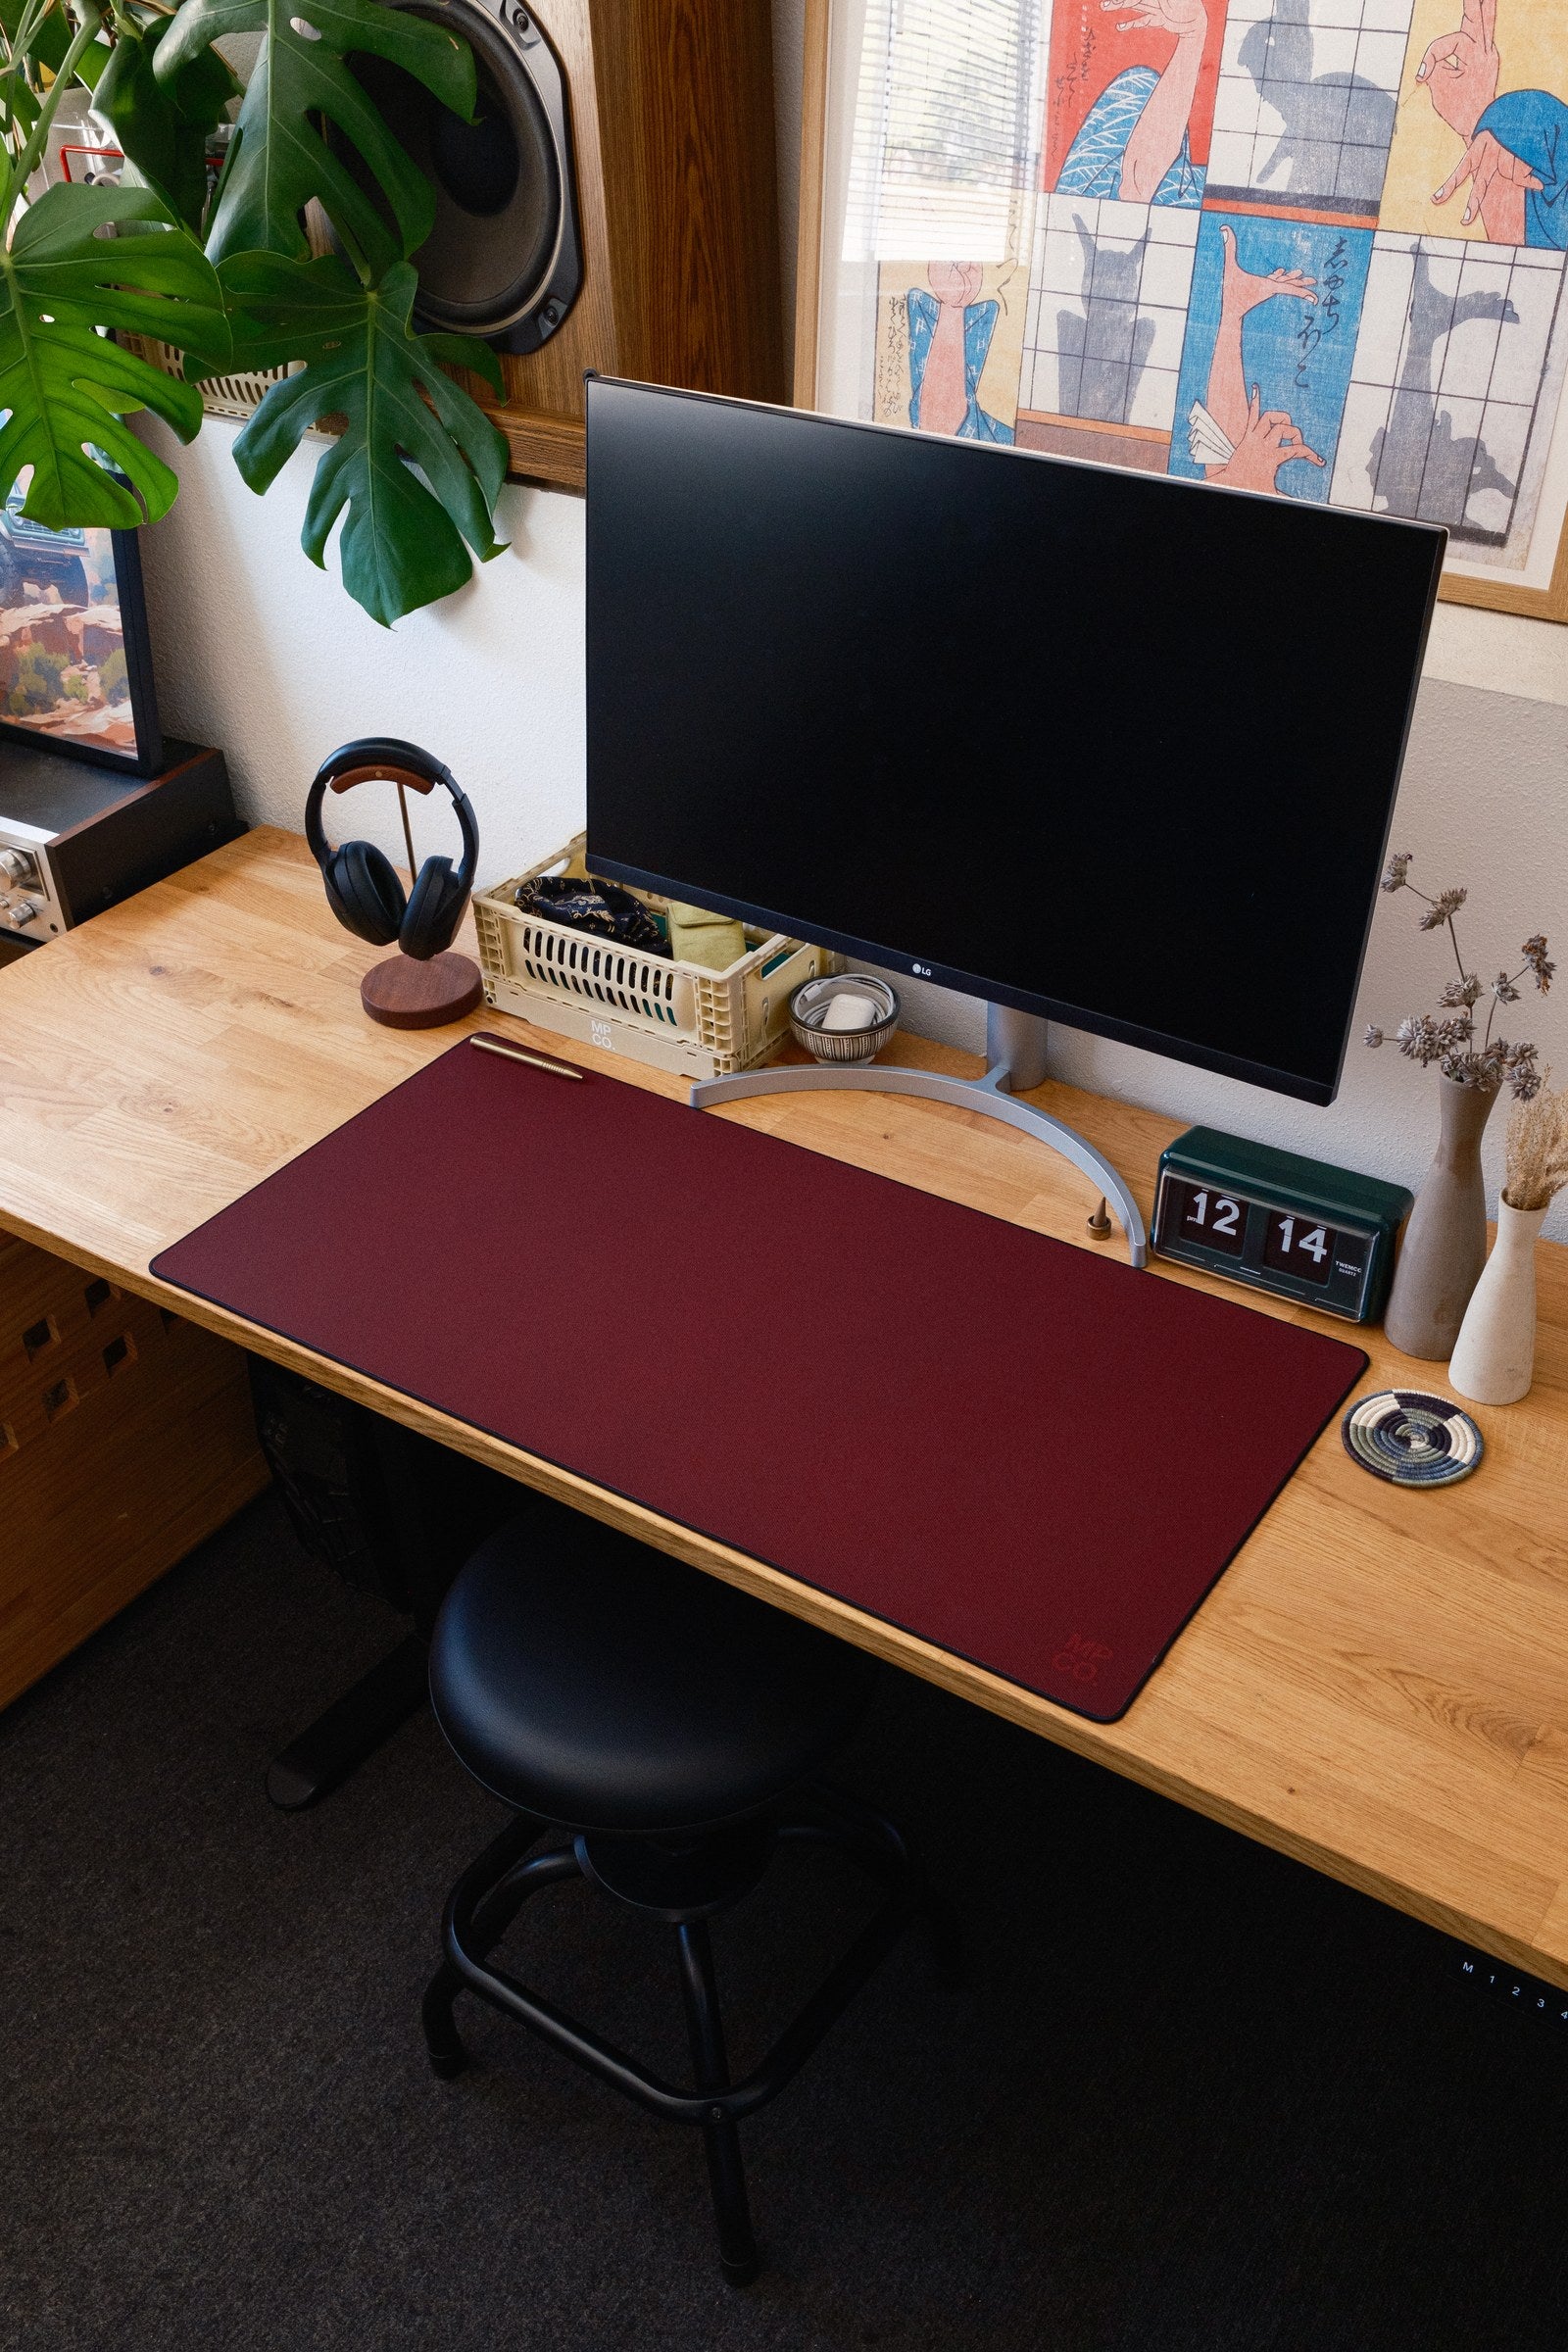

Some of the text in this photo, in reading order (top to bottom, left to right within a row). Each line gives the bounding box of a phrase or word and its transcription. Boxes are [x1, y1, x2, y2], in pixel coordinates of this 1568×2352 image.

[591, 1020, 612, 1036] MP
[592, 1033, 615, 1051] CO.
[1192, 1191, 1241, 1237] 12
[1277, 1218, 1328, 1264] 14
[1335, 1260, 1362, 1273] TWEMCO
[1064, 1633, 1114, 1663] MP
[1462, 1961, 1568, 2020] M 1 2 3 4
